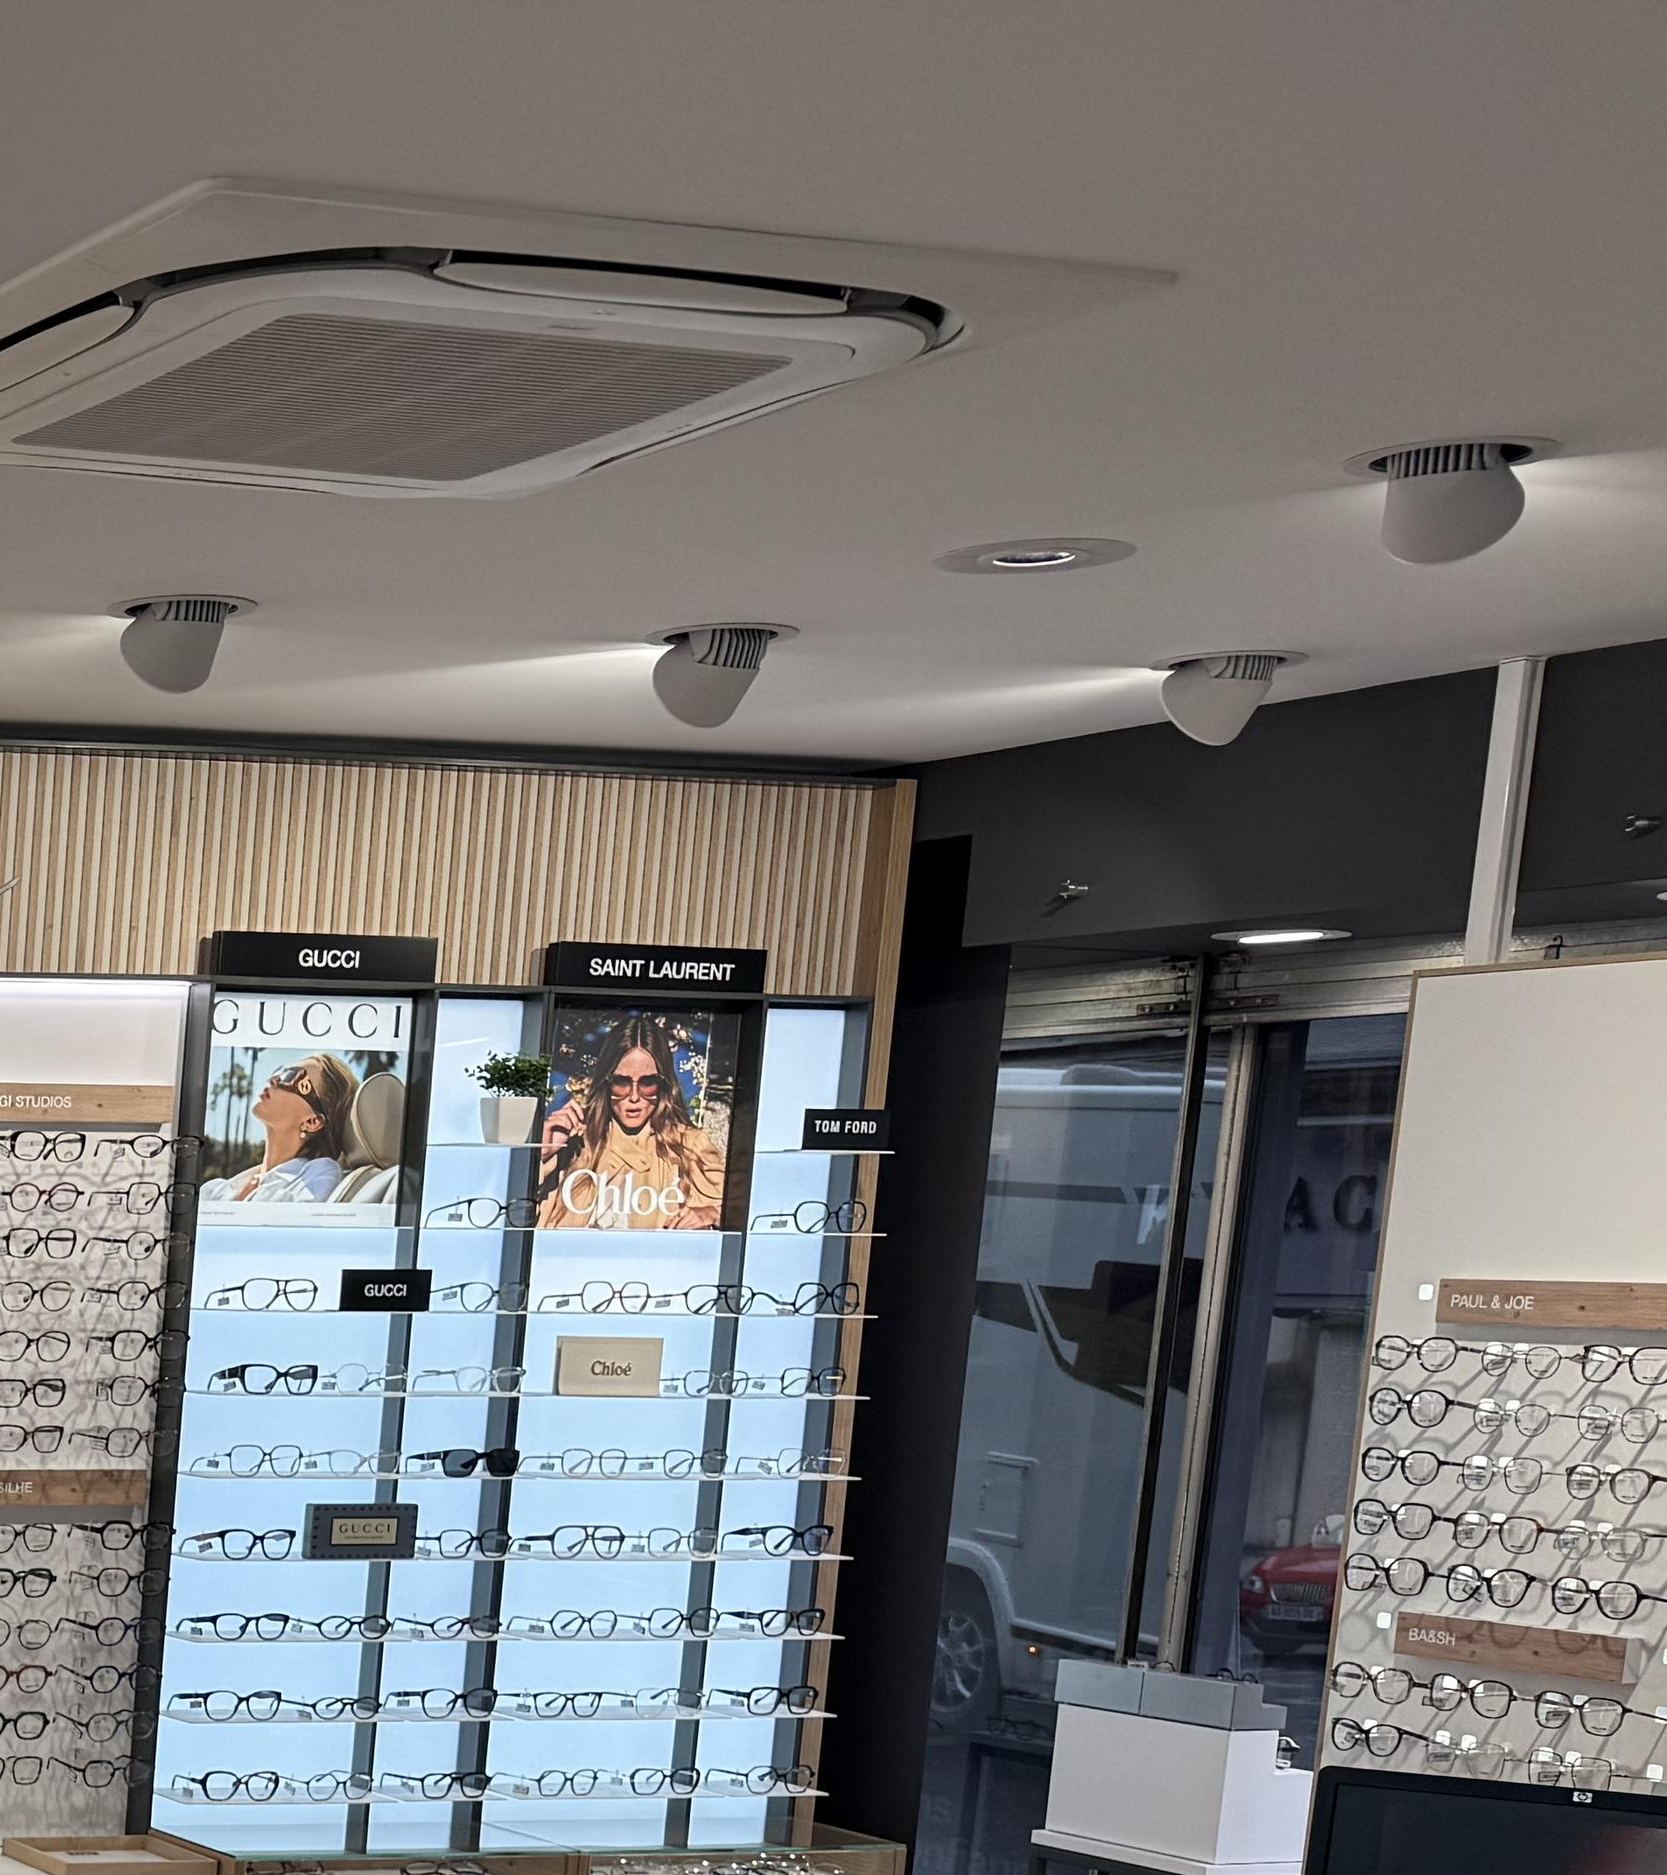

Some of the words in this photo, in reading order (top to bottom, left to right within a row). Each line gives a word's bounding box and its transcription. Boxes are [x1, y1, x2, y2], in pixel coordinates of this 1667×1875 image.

[298, 948, 360, 968] GUCCI
[589, 957, 645, 978] SAINT
[648, 960, 735, 981] LAURENT
[212, 998, 402, 1039] GUCCI
[15, 1095, 72, 1109] STUDIOS
[814, 1119, 841, 1133] TOM
[844, 1120, 877, 1134] FORD
[561, 1168, 685, 1216] Chloé
[363, 1283, 407, 1297] GUCCI
[1450, 1293, 1488, 1309] PAUL
[1490, 1294, 1501, 1309] &
[1504, 1295, 1535, 1310] JOE
[590, 1359, 632, 1376] Chloé
[338, 1523, 391, 1534] GUCCI
[1408, 1627, 1456, 1646] BA&SH
